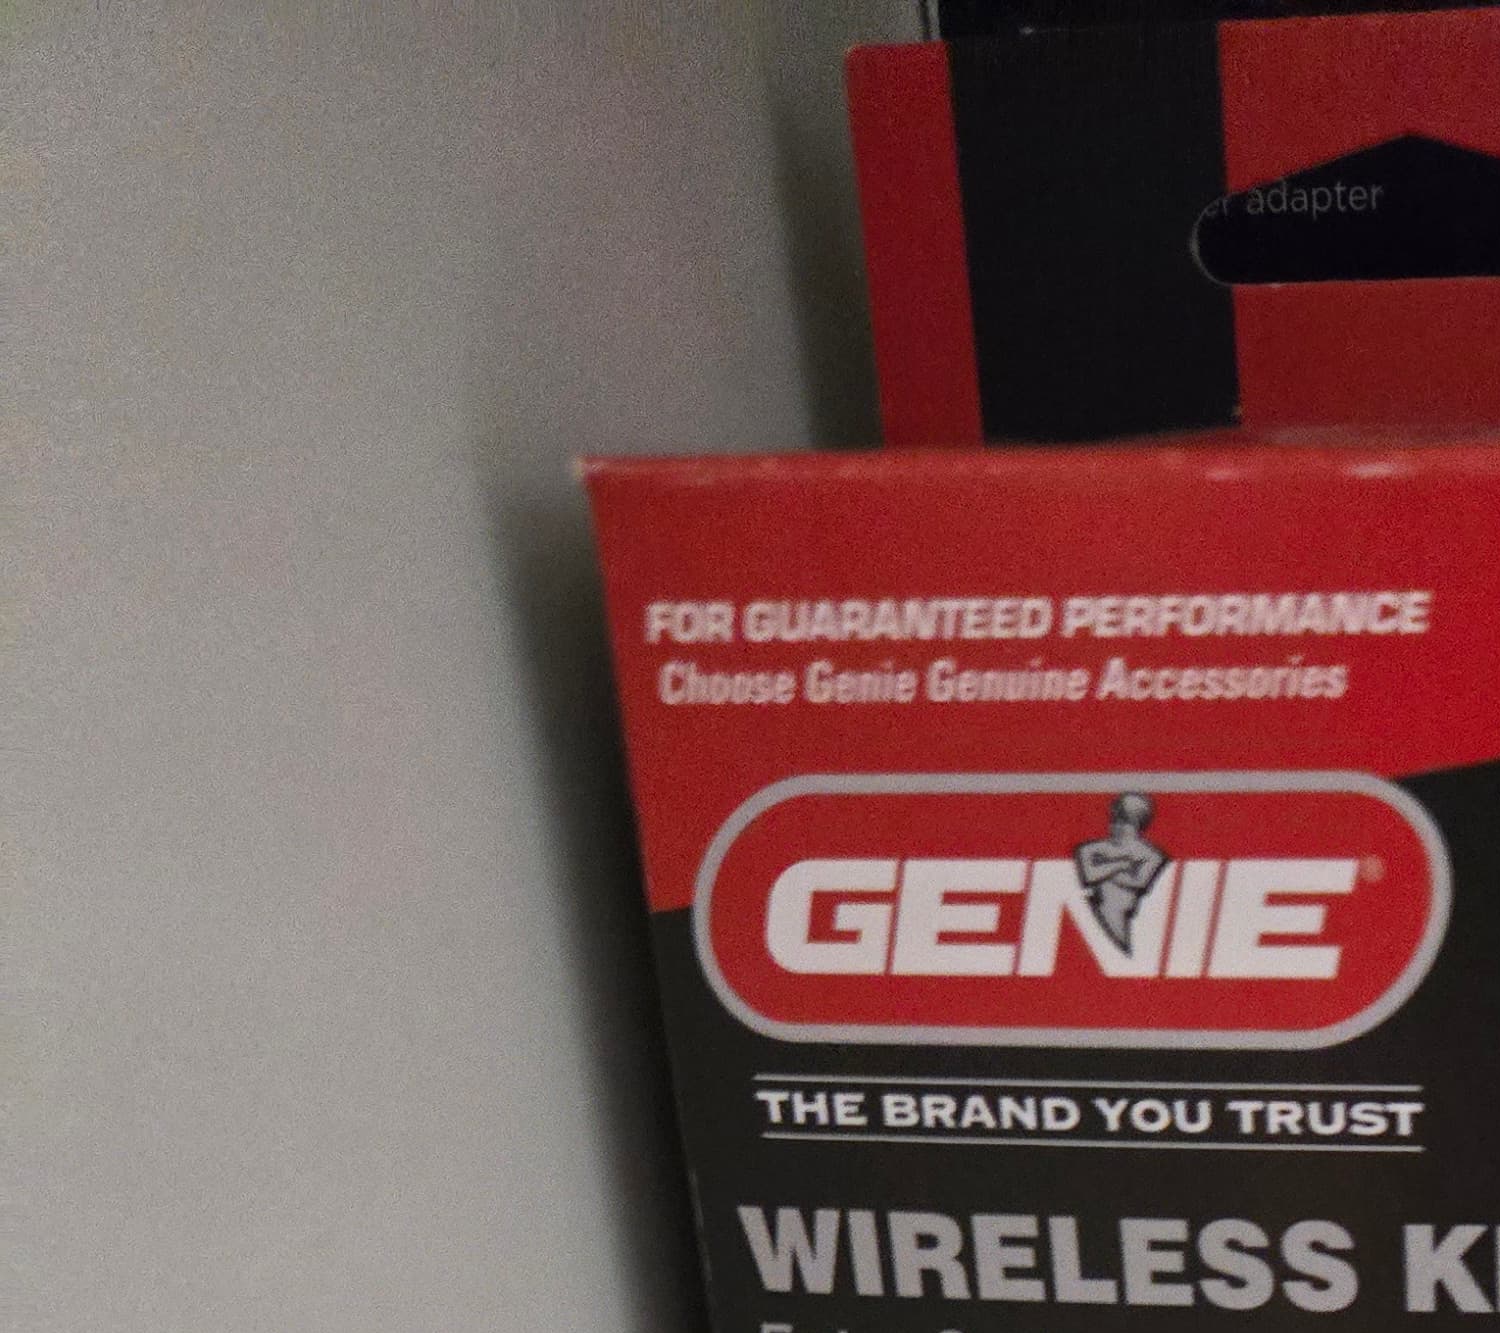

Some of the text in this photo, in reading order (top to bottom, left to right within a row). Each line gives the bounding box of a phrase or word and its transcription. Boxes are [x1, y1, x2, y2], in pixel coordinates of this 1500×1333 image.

[1247, 176, 1385, 221] adapter
[645, 590, 1433, 645] FOR GUARANTEED PERFORMANCE
[658, 654, 1348, 707] Choose Genie Genuine Accessories
[756, 1090, 1424, 1138] THE BRAND YOU TRUST
[738, 1206, 1360, 1313] WIRELESS
